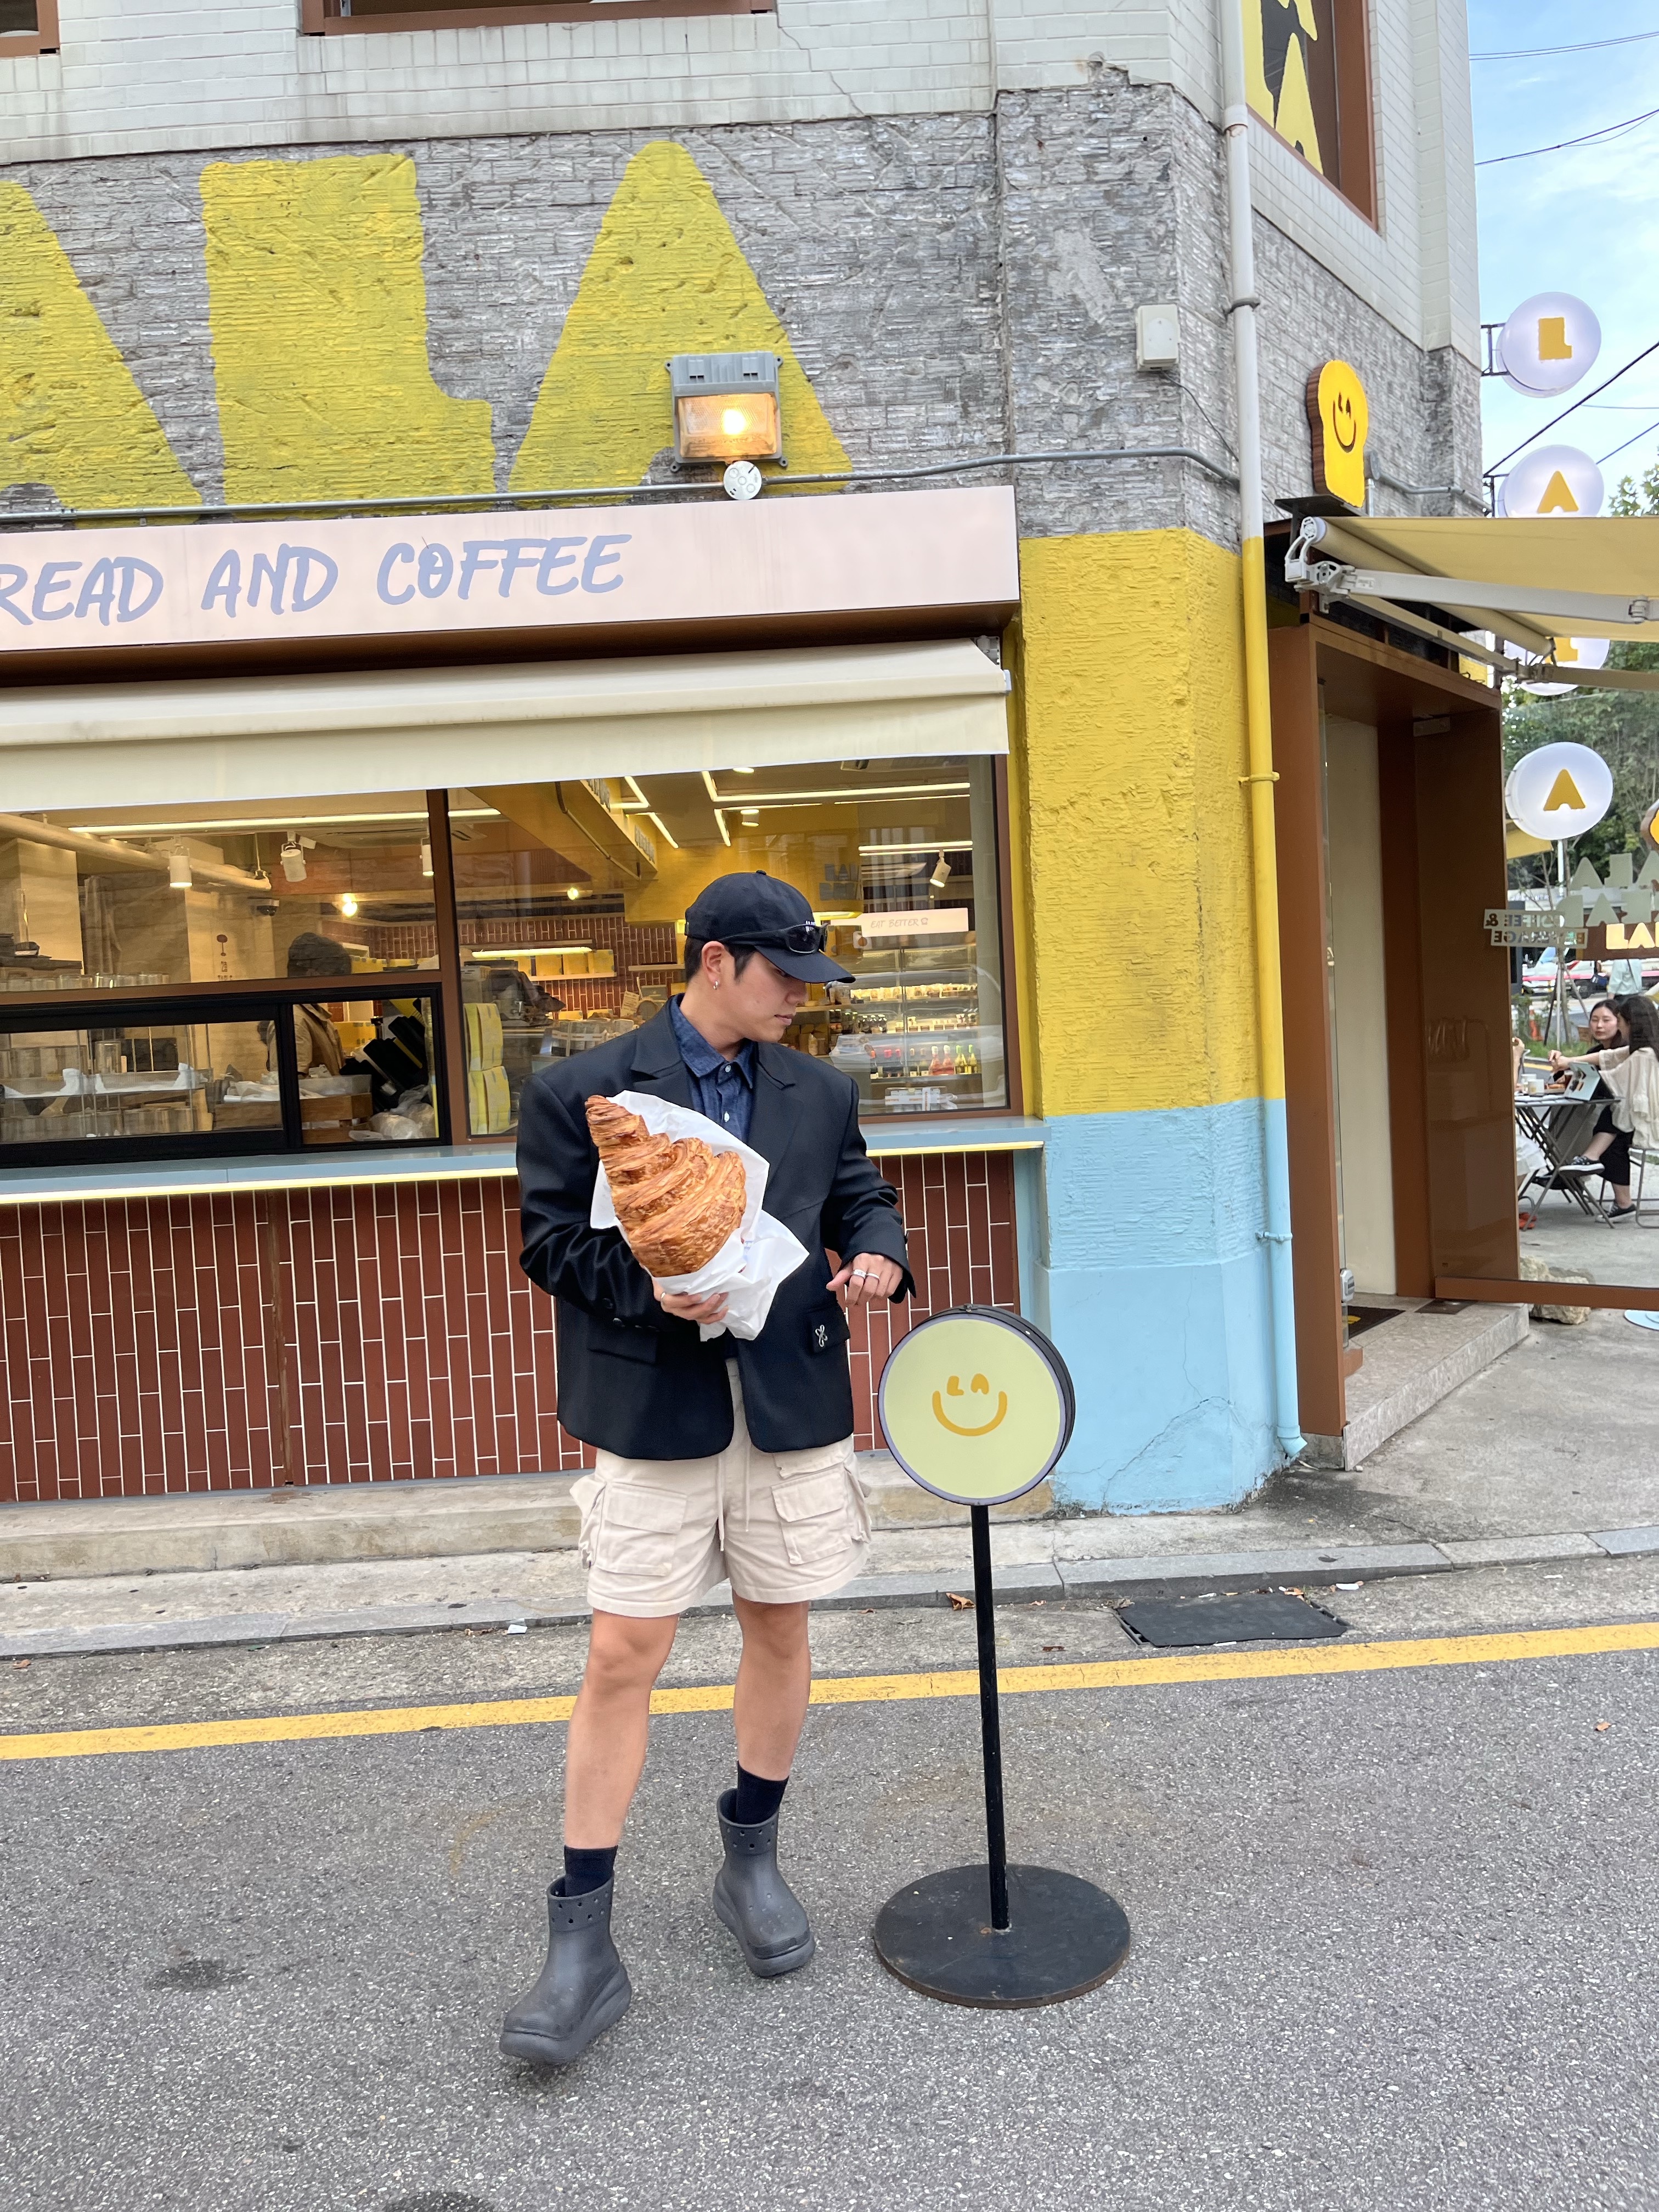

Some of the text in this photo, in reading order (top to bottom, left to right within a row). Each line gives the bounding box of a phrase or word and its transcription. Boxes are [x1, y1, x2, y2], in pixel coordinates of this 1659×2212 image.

[201, 543, 338, 618] AND
[376, 534, 632, 607] COFFEE
[871, 918, 919, 929] EAT BETTER
